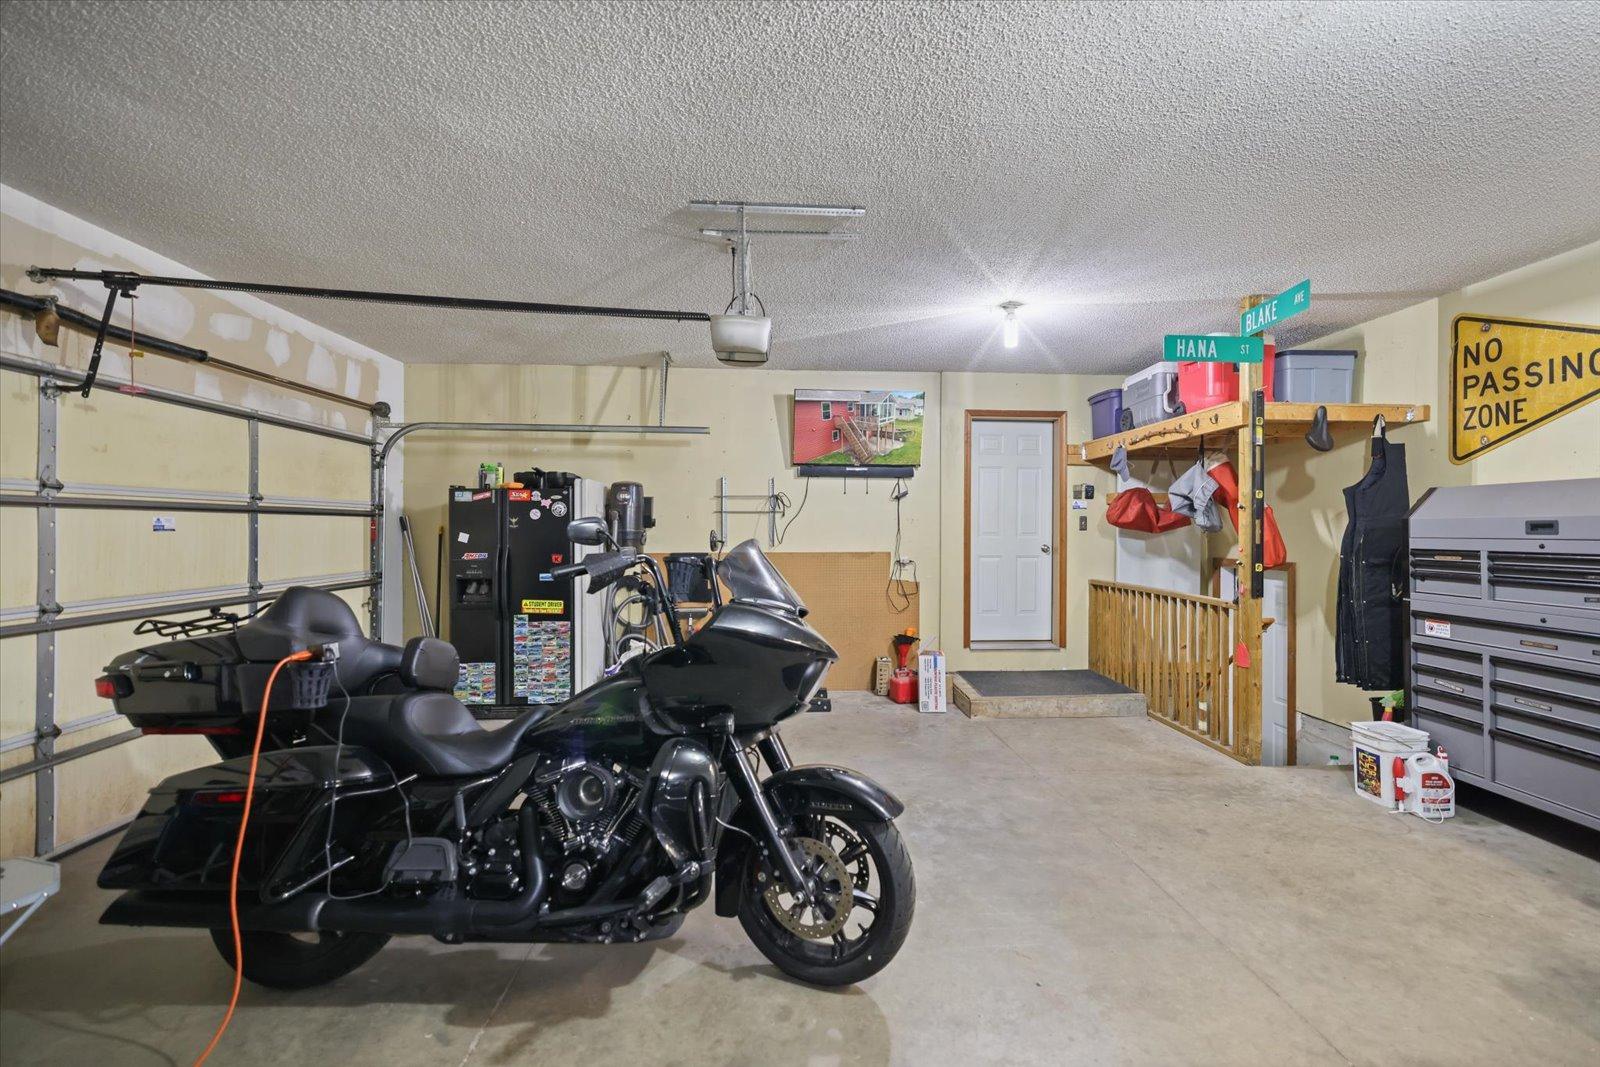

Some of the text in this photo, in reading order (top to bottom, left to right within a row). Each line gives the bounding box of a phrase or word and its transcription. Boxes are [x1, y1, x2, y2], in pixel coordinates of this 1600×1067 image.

[1246, 290, 1305, 333] BLAKE AVE
[1177, 339, 1250, 358] HANA ST
[1463, 338, 1503, 369] NO
[1463, 397, 1528, 431] ZONE
